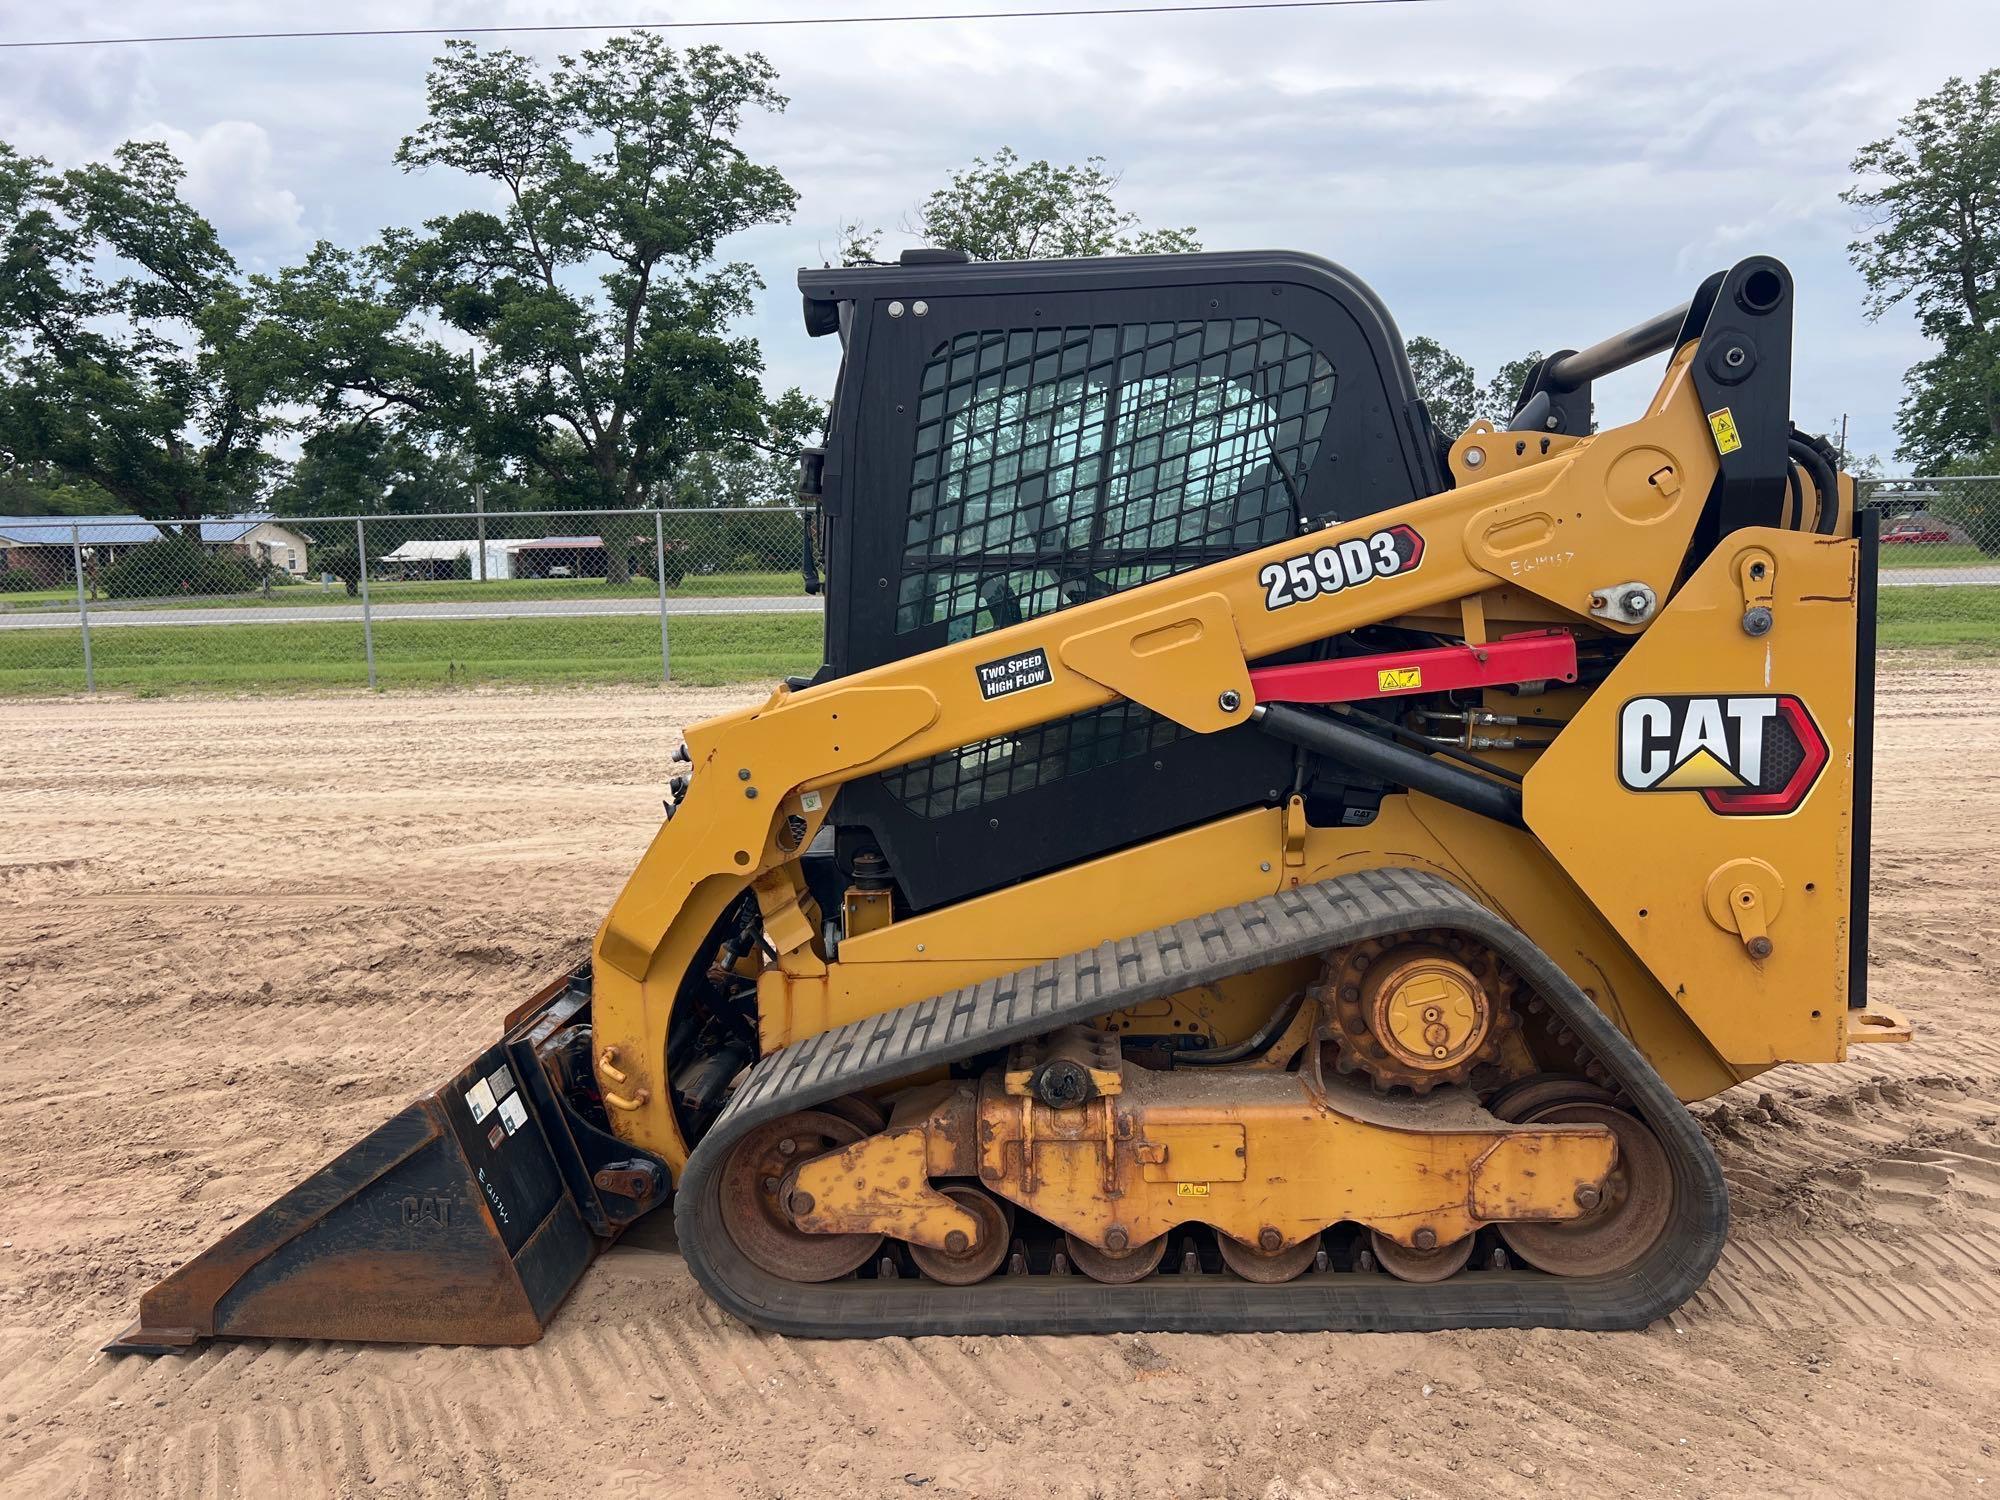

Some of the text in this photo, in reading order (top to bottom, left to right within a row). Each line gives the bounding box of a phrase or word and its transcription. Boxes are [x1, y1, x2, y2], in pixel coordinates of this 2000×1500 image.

[1260, 532, 1401, 609] 259D3
[980, 655, 1042, 681] TWO SPEED
[986, 669, 1045, 696] HIGH FLOW
[1622, 697, 1777, 788] CAT
[1353, 809, 1371, 818] CAT
[401, 1196, 452, 1227] CAT
